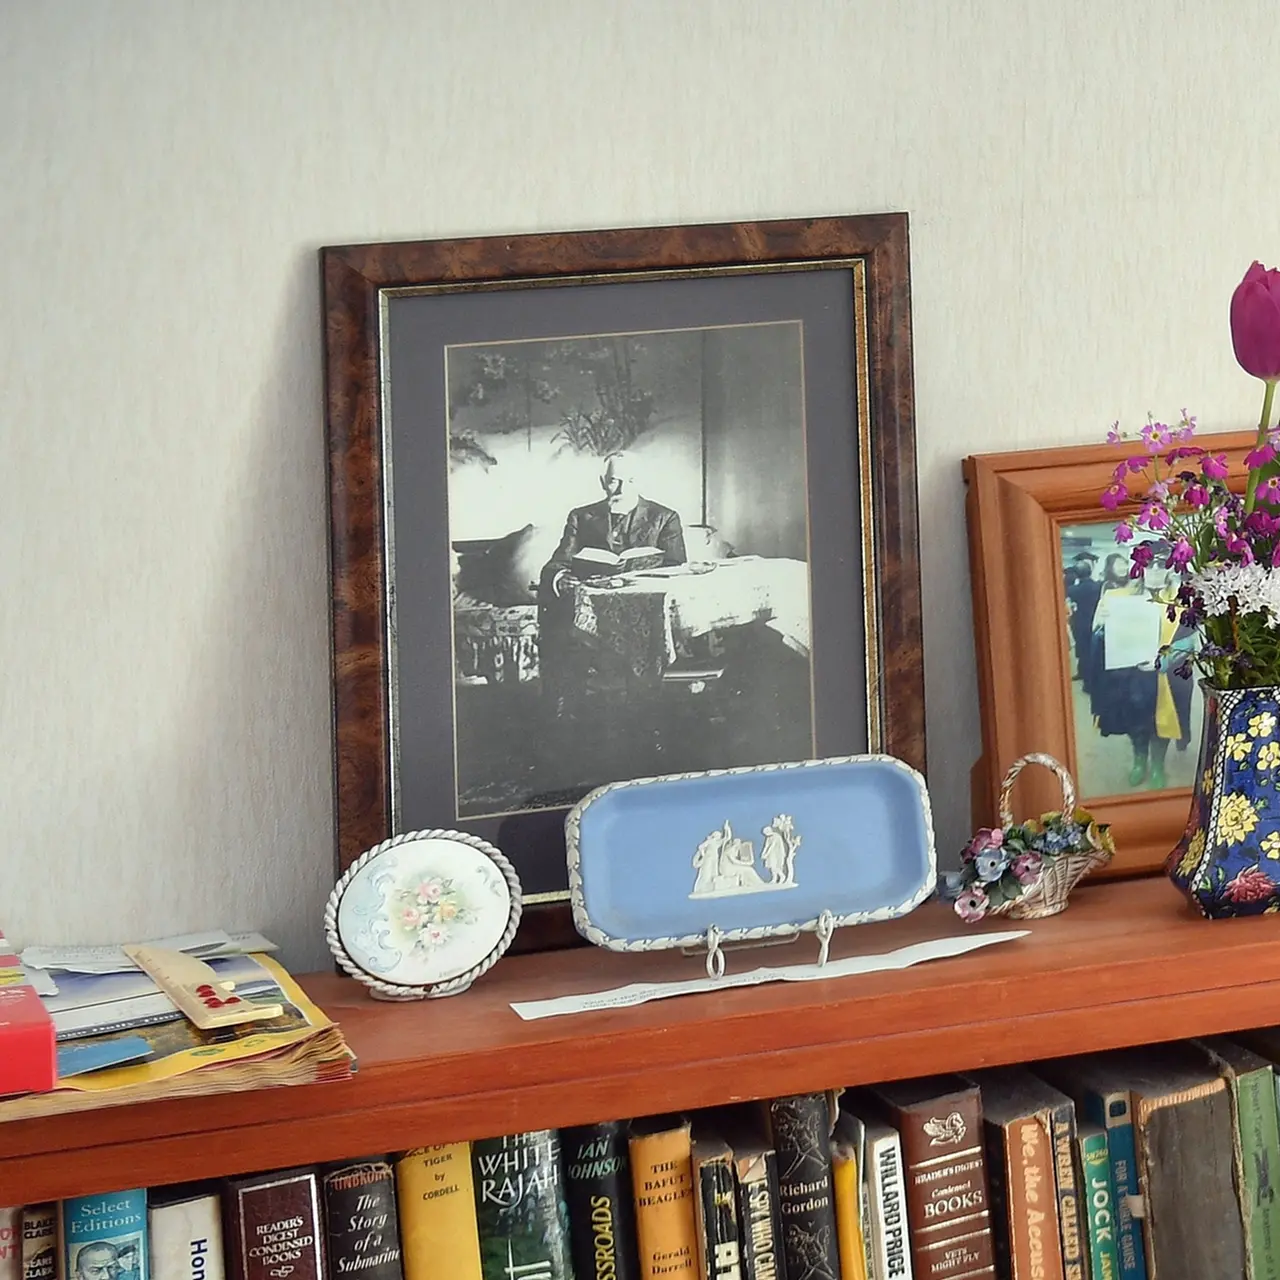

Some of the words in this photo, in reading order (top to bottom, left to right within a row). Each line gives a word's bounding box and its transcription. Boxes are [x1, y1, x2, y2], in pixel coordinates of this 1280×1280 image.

[423, 1154, 453, 1168] TIGER
[479, 1138, 562, 1176] WHITE
[650, 1161, 678, 1175] THE
[423, 1184, 460, 1201] CORDELL
[481, 1164, 559, 1212] RAJAH
[644, 1174, 686, 1191] BAFUT
[779, 1176, 828, 1198] Richard
[879, 1146, 901, 1227] WILLARD
[1024, 1166, 1043, 1204] the
[81, 1200, 131, 1217] Select
[355, 1194, 382, 1212] The
[781, 1195, 829, 1216] Gordon
[923, 1191, 983, 1218] BOOKS
[1091, 1177, 1112, 1244] JOCK
[71, 1214, 142, 1234] Editions
[256, 1215, 304, 1236] READER'S
[348, 1211, 389, 1232] Story
[249, 1235, 314, 1258] CONDENSED
[652, 1246, 691, 1262] Gerald
[261, 1249, 302, 1268] BOOKS
[651, 1260, 693, 1275] Durrell
